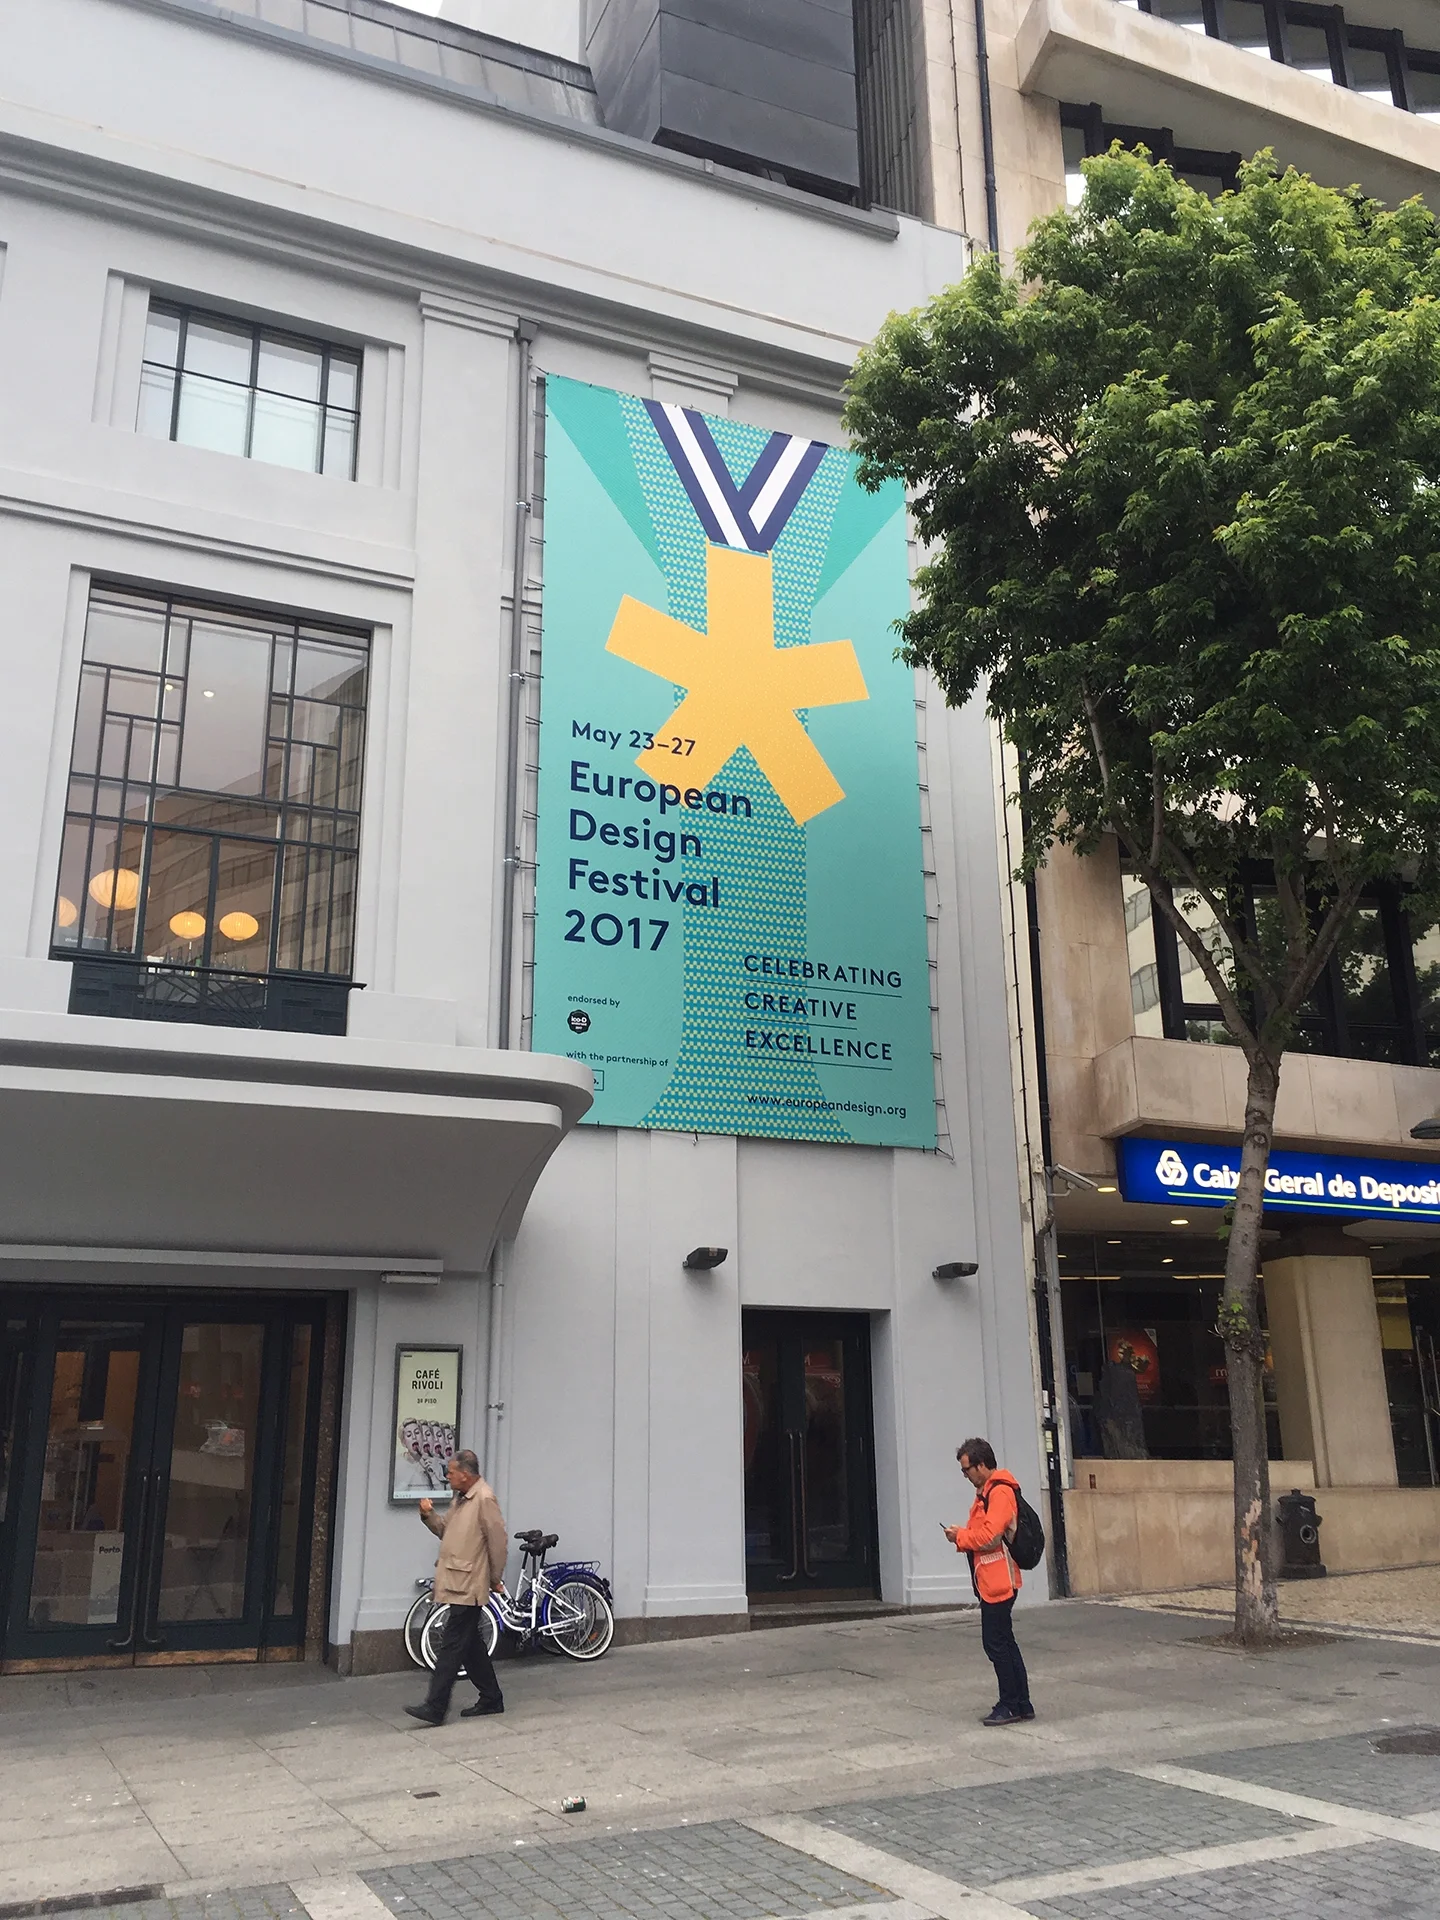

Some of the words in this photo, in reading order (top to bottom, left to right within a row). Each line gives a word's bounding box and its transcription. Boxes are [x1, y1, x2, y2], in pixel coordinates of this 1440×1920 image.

[572, 720, 622, 750] May
[570, 760, 752, 817] European
[569, 808, 702, 863] Design
[569, 858, 719, 908] Festival
[563, 909, 670, 951] 2017
[743, 955, 902, 988] CELEBRATING
[567, 995, 607, 1005] endorsed
[609, 998, 620, 1008] by
[744, 992, 857, 1020] CREATIVE
[566, 1050, 587, 1059] with
[589, 1052, 605, 1061] the
[606, 1055, 657, 1067] partnership
[659, 1058, 669, 1067] of
[745, 1030, 893, 1061] EXCELLENCE
[747, 1095, 907, 1119] www.europeandesign.org
[1193, 1163, 1241, 1189] Caix
[1264, 1168, 1324, 1197] Geral
[1328, 1174, 1357, 1199] de
[1360, 1175, 1440, 1208] Deposi
[411, 1380, 443, 1389] RIVOLI
[415, 1368, 440, 1379] CAFÉ
